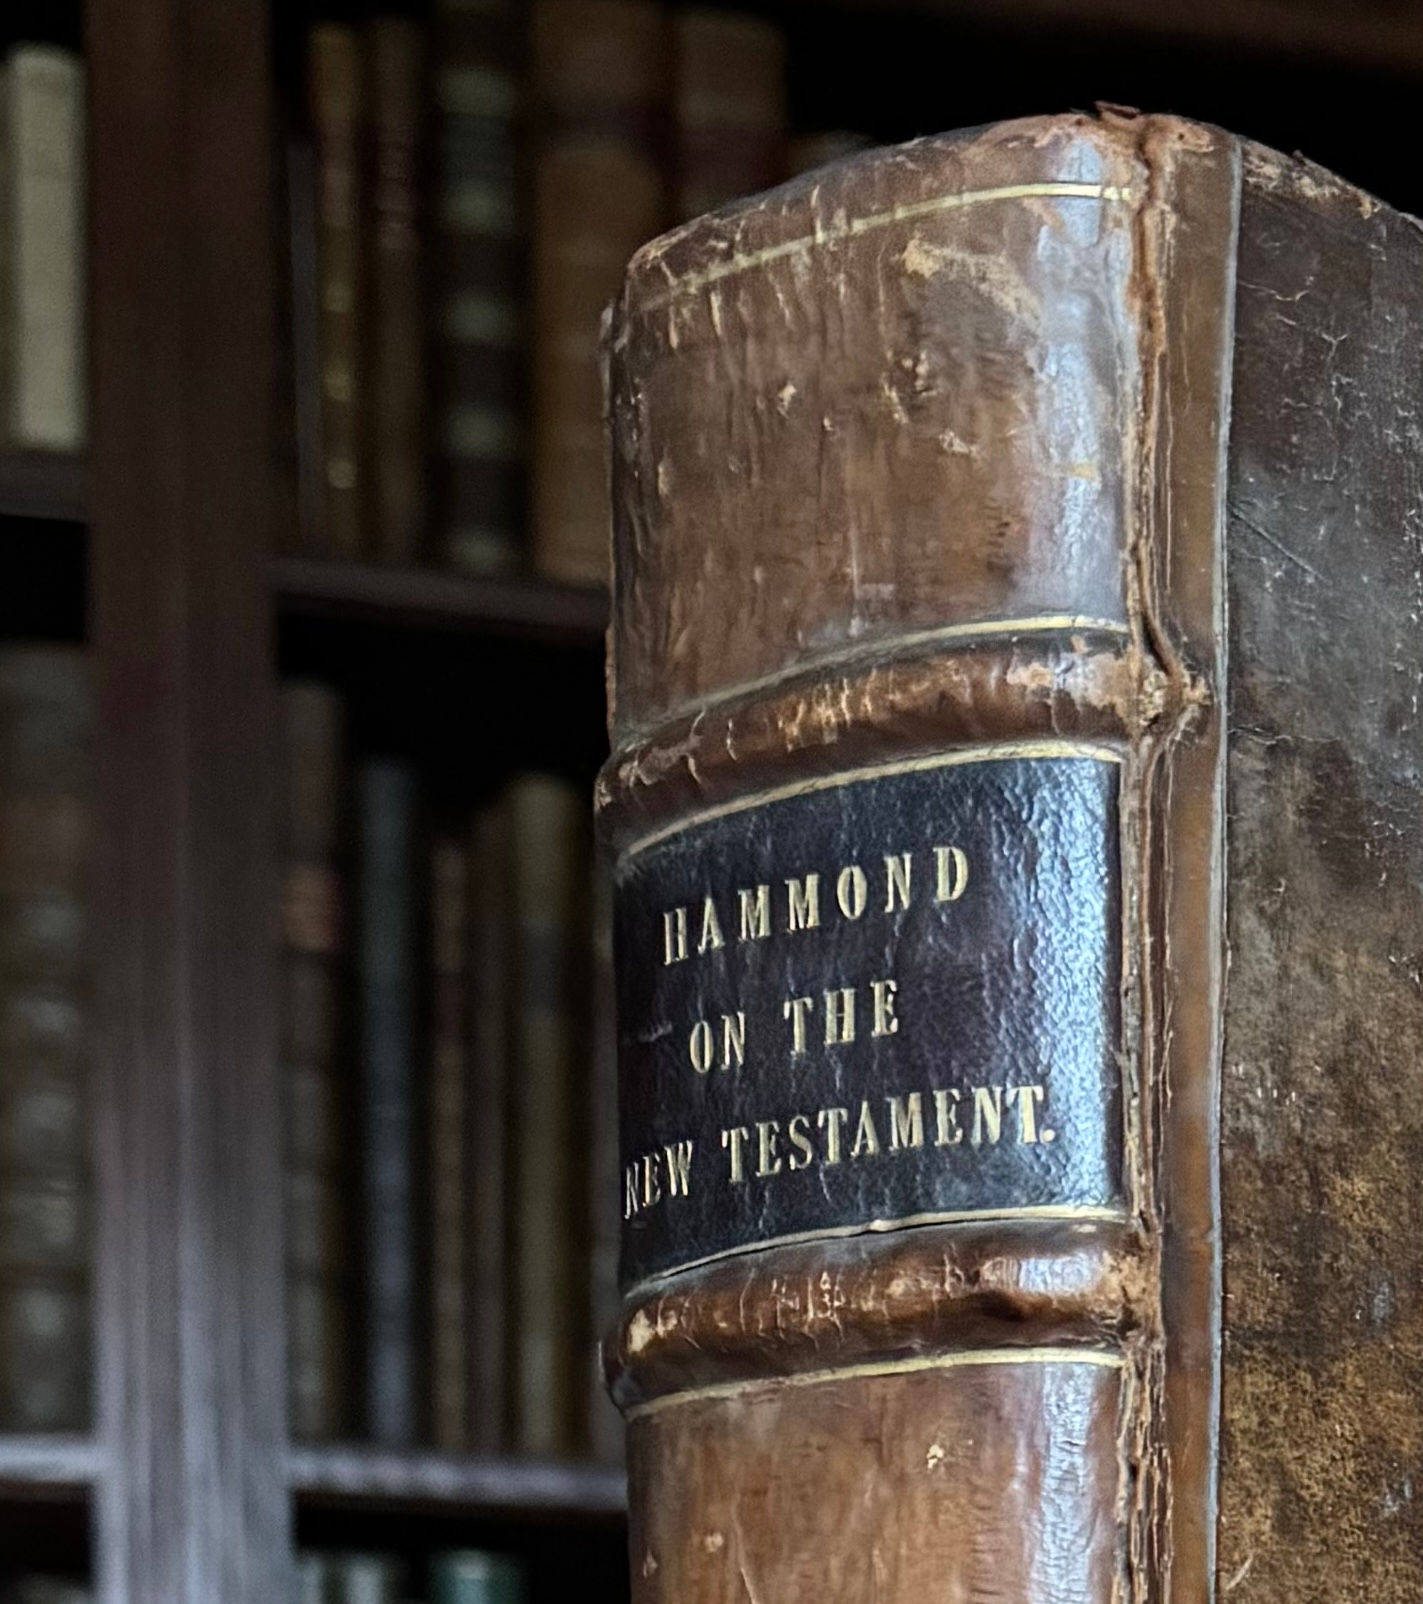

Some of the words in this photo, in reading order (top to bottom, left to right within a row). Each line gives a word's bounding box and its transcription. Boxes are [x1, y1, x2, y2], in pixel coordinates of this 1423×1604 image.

[662, 846, 969, 966] HAMMOND
[689, 1012, 746, 1074] ON
[783, 979, 899, 1057] THE
[623, 1139, 694, 1220] NEW
[721, 1085, 1056, 1183] TESTAMENT.
